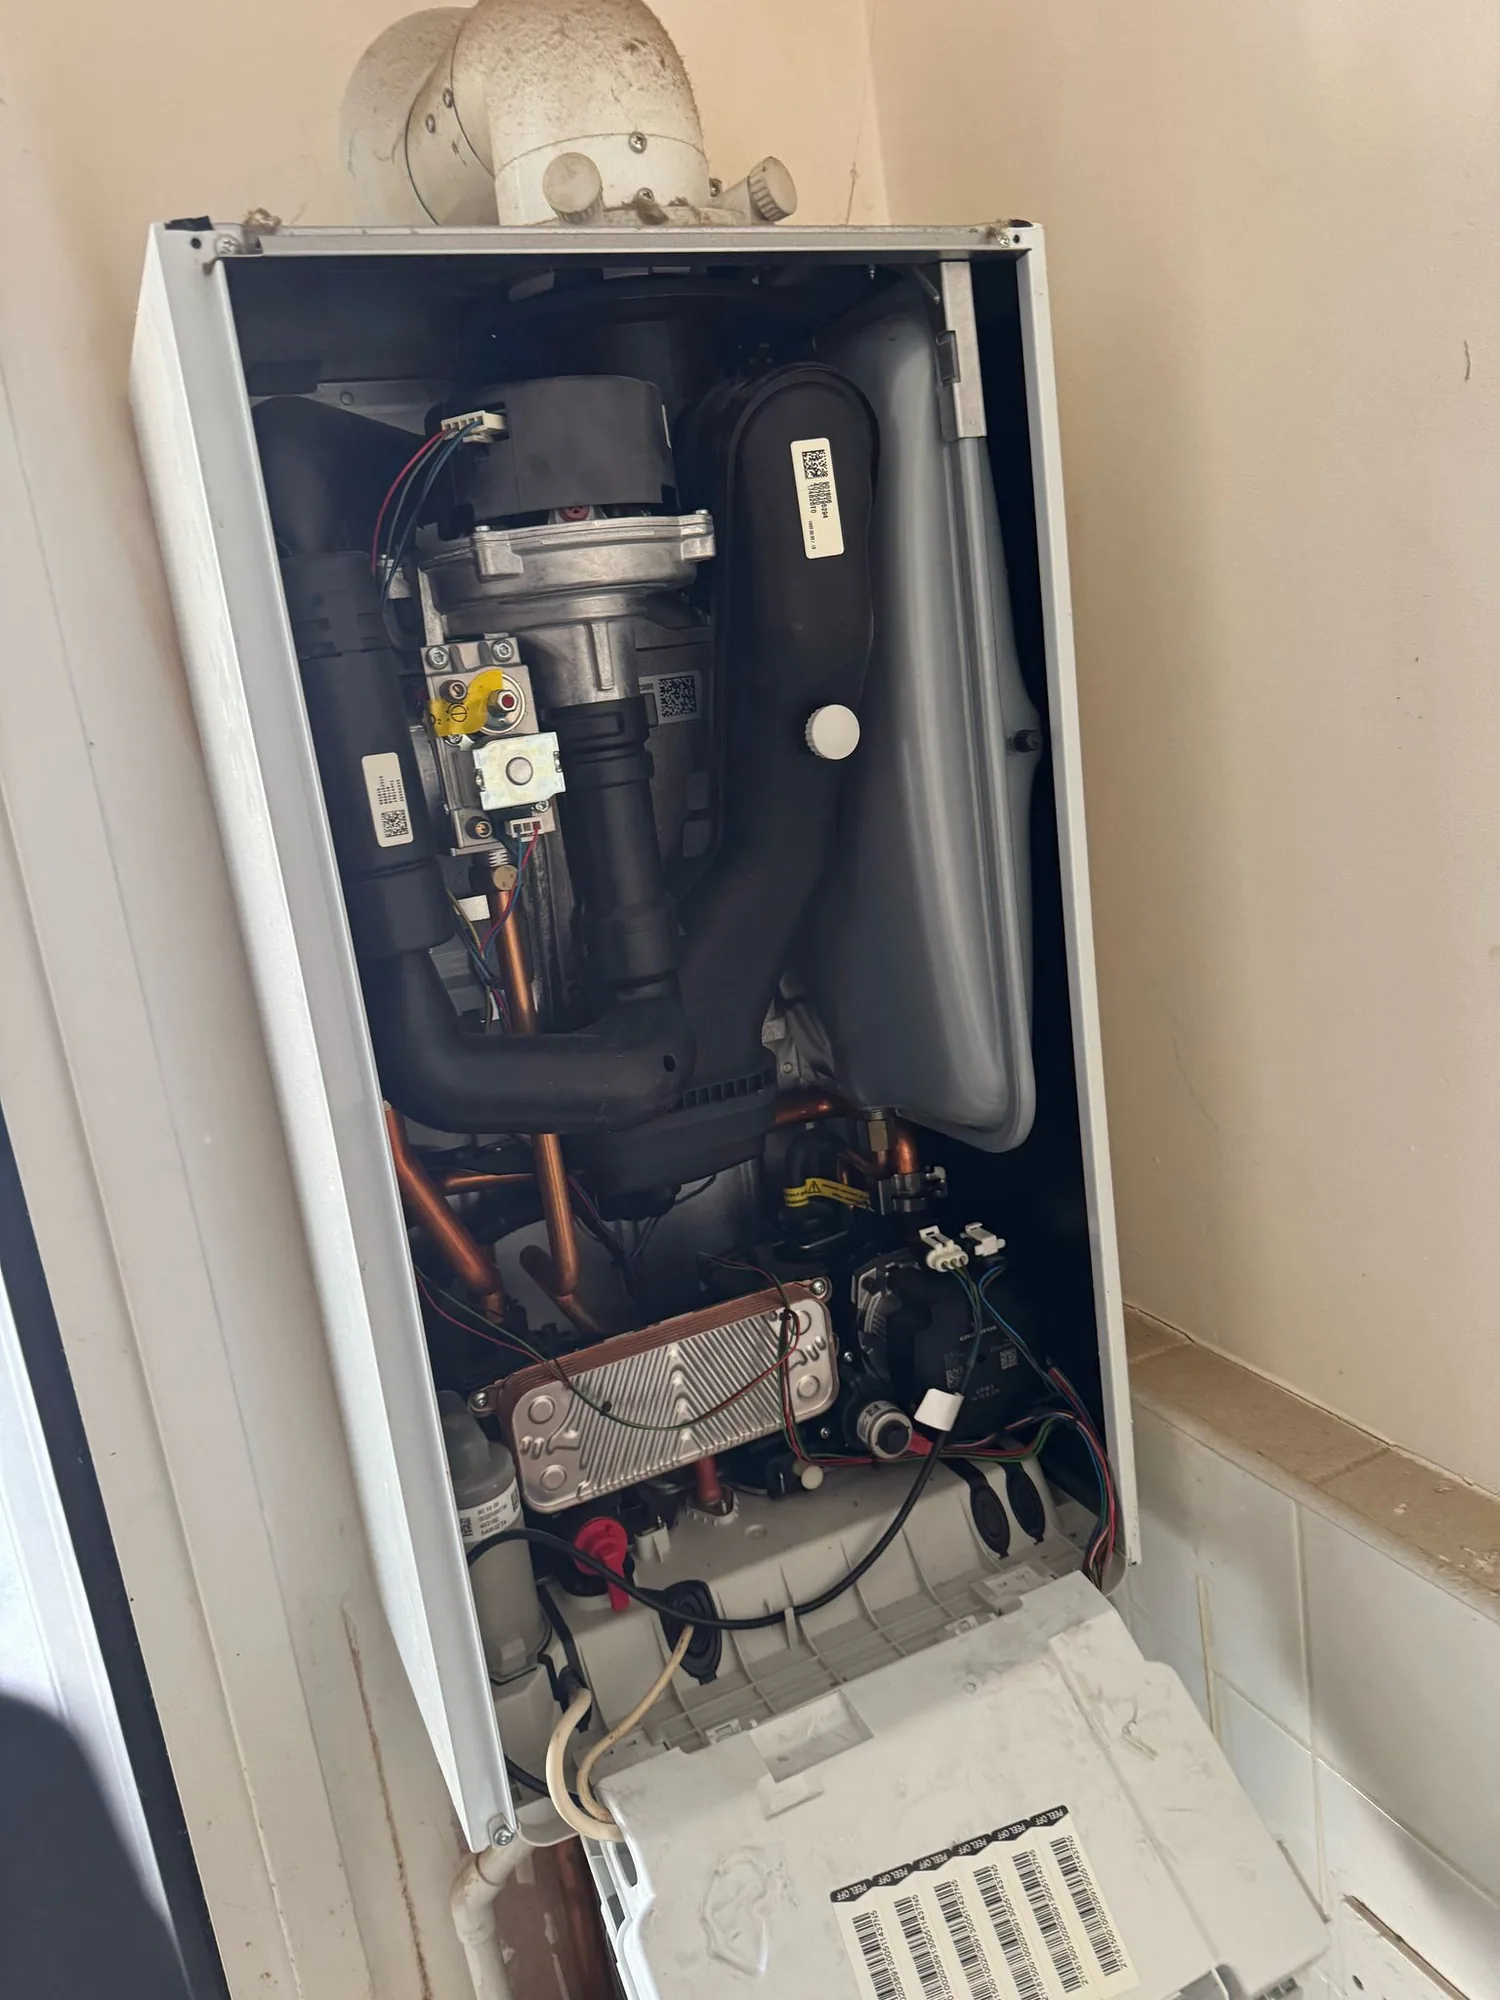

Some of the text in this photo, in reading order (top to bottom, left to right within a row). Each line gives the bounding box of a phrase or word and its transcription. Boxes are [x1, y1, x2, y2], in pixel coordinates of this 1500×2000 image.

[1035, 1808, 1064, 1826] PEEL OFF
[997, 1822, 1026, 1840] PEEL OFF
[958, 1838, 988, 1855] PEEL OFF
[919, 1852, 949, 1870] PEEL OFF
[878, 1867, 909, 1885] PEEL OFF
[836, 1883, 868, 1901] PEEL OFF
[951, 1879, 1001, 2000] 1500100203891300511437N5
